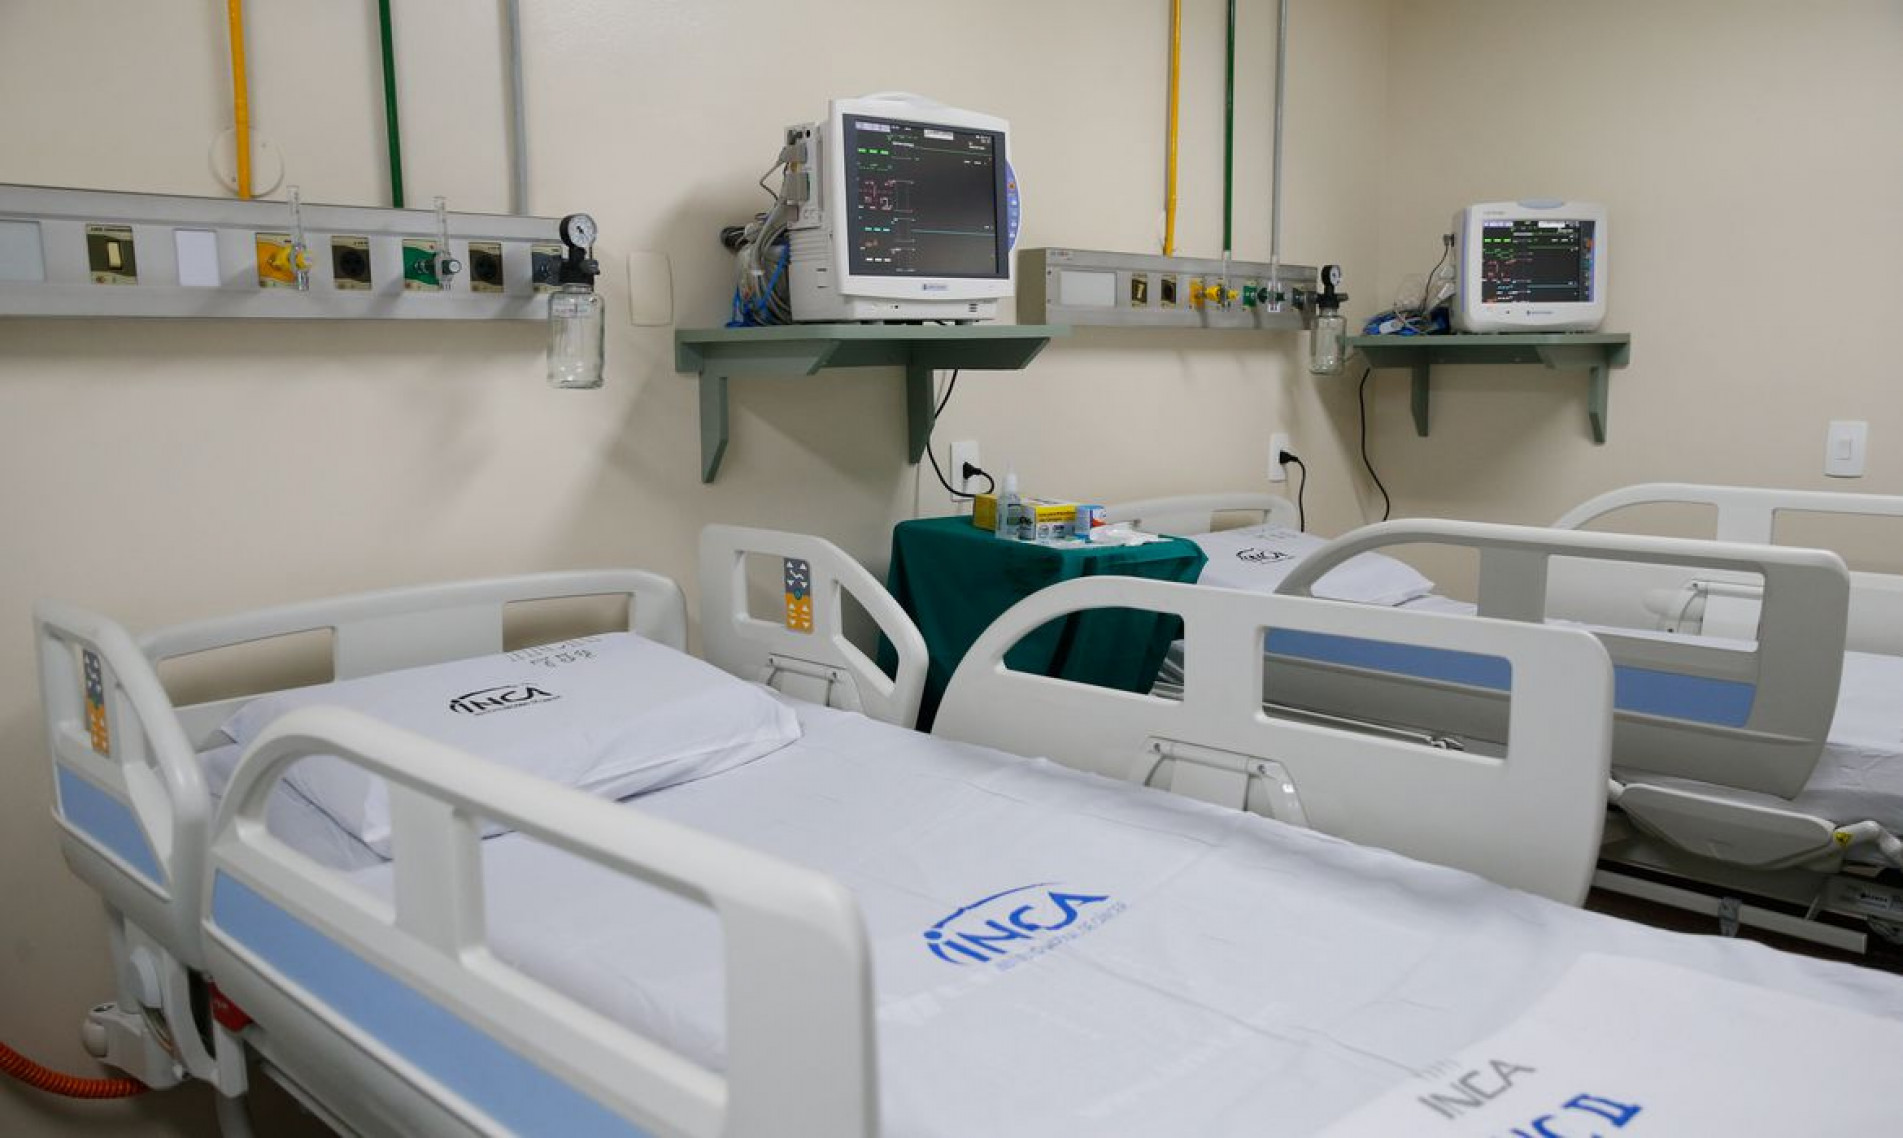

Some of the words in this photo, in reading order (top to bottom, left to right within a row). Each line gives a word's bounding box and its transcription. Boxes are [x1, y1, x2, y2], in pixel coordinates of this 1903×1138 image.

[458, 686, 554, 713] INCA
[944, 890, 1110, 962] INCA
[1416, 1059, 1536, 1120] INCA
